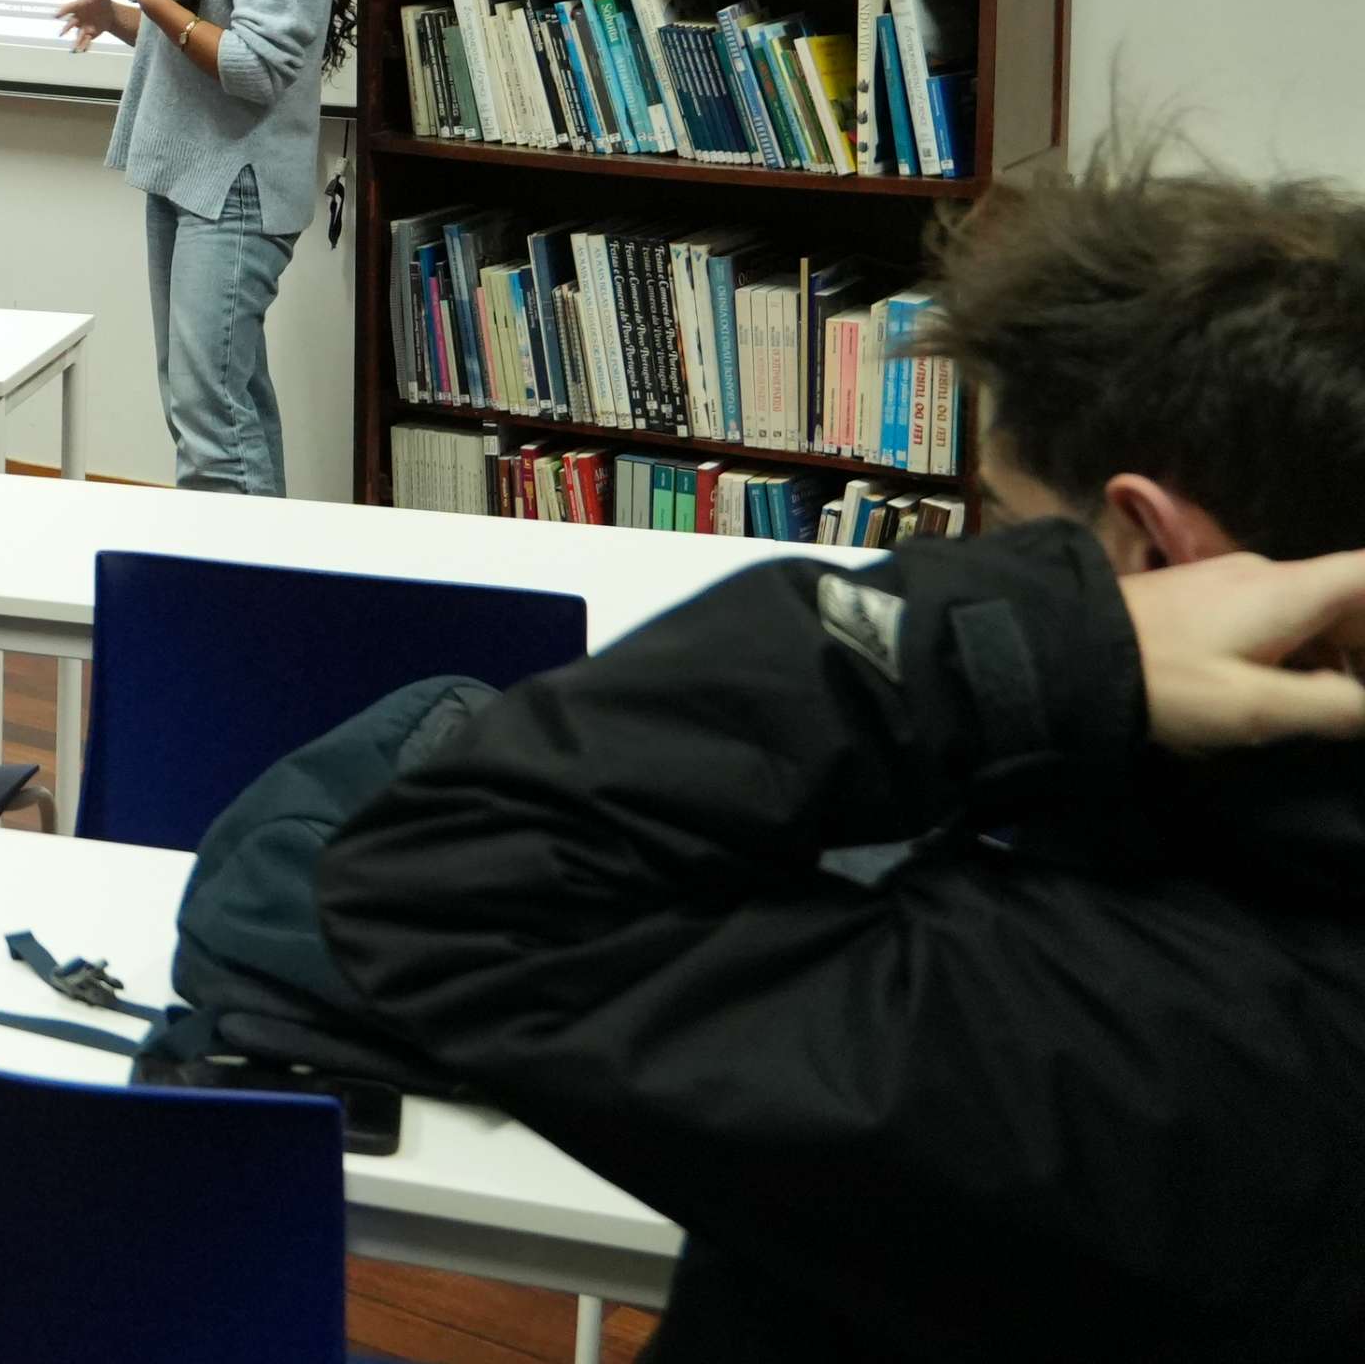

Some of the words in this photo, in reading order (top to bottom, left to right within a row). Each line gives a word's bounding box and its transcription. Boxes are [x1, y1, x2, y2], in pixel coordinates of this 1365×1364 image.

[610, 240, 620, 268] Festas
[625, 242, 635, 269] Festas
[655, 245, 665, 273] Festas
[614, 275, 626, 310] Comeres
[629, 277, 640, 312] Comeres
[658, 280, 670, 316] Comeres
[622, 322, 632, 345] Povo
[637, 324, 646, 347] Povo
[666, 328, 675, 350] Povo
[625, 345, 639, 387] Português
[640, 347, 653, 389] Português
[669, 350, 681, 394] Português
[723, 369, 734, 404] GRANDE
[914, 403, 926, 421] DO
